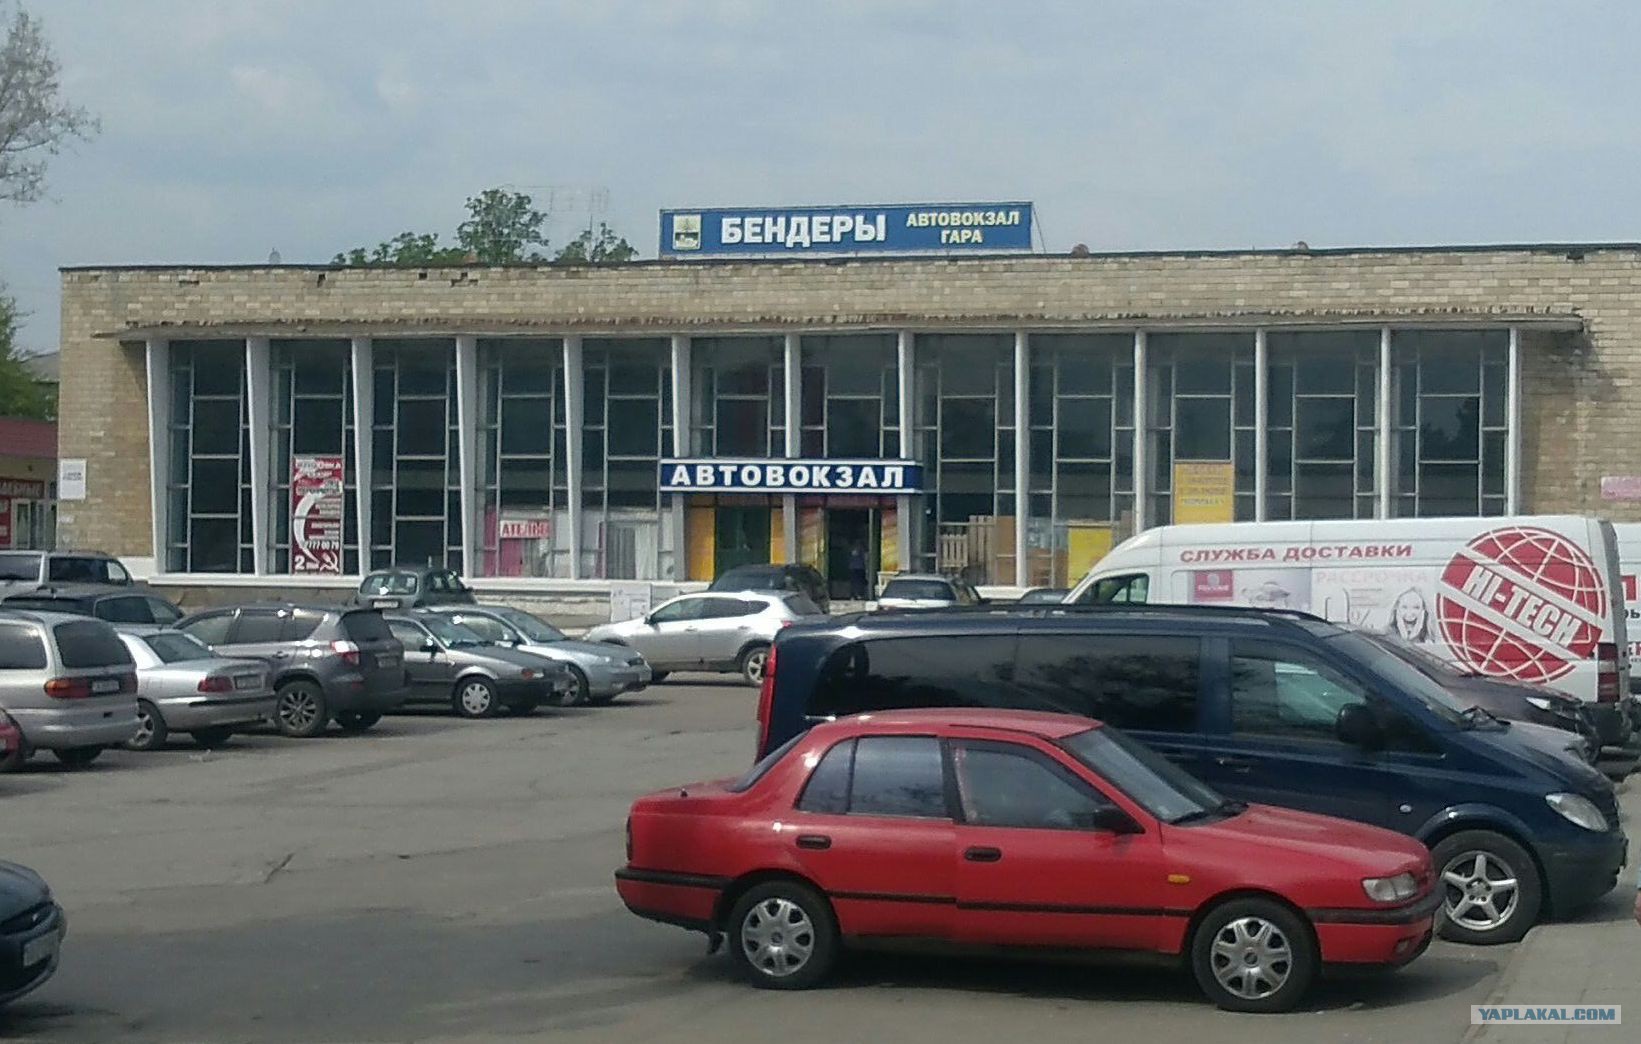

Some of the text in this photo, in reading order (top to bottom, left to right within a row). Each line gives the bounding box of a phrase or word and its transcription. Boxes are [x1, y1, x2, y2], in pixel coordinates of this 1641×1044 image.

[906, 211, 1020, 228] АВТОВОКЗАЛ
[721, 213, 886, 248] БЕНДЕРЫ
[941, 229, 983, 244] ГАРА
[671, 465, 904, 488] АВТОВОКЗАЛ
[1180, 545, 1412, 563] СЛУЖБА ДОСТАВКИ
[1461, 564, 1582, 647] HI-TECH
